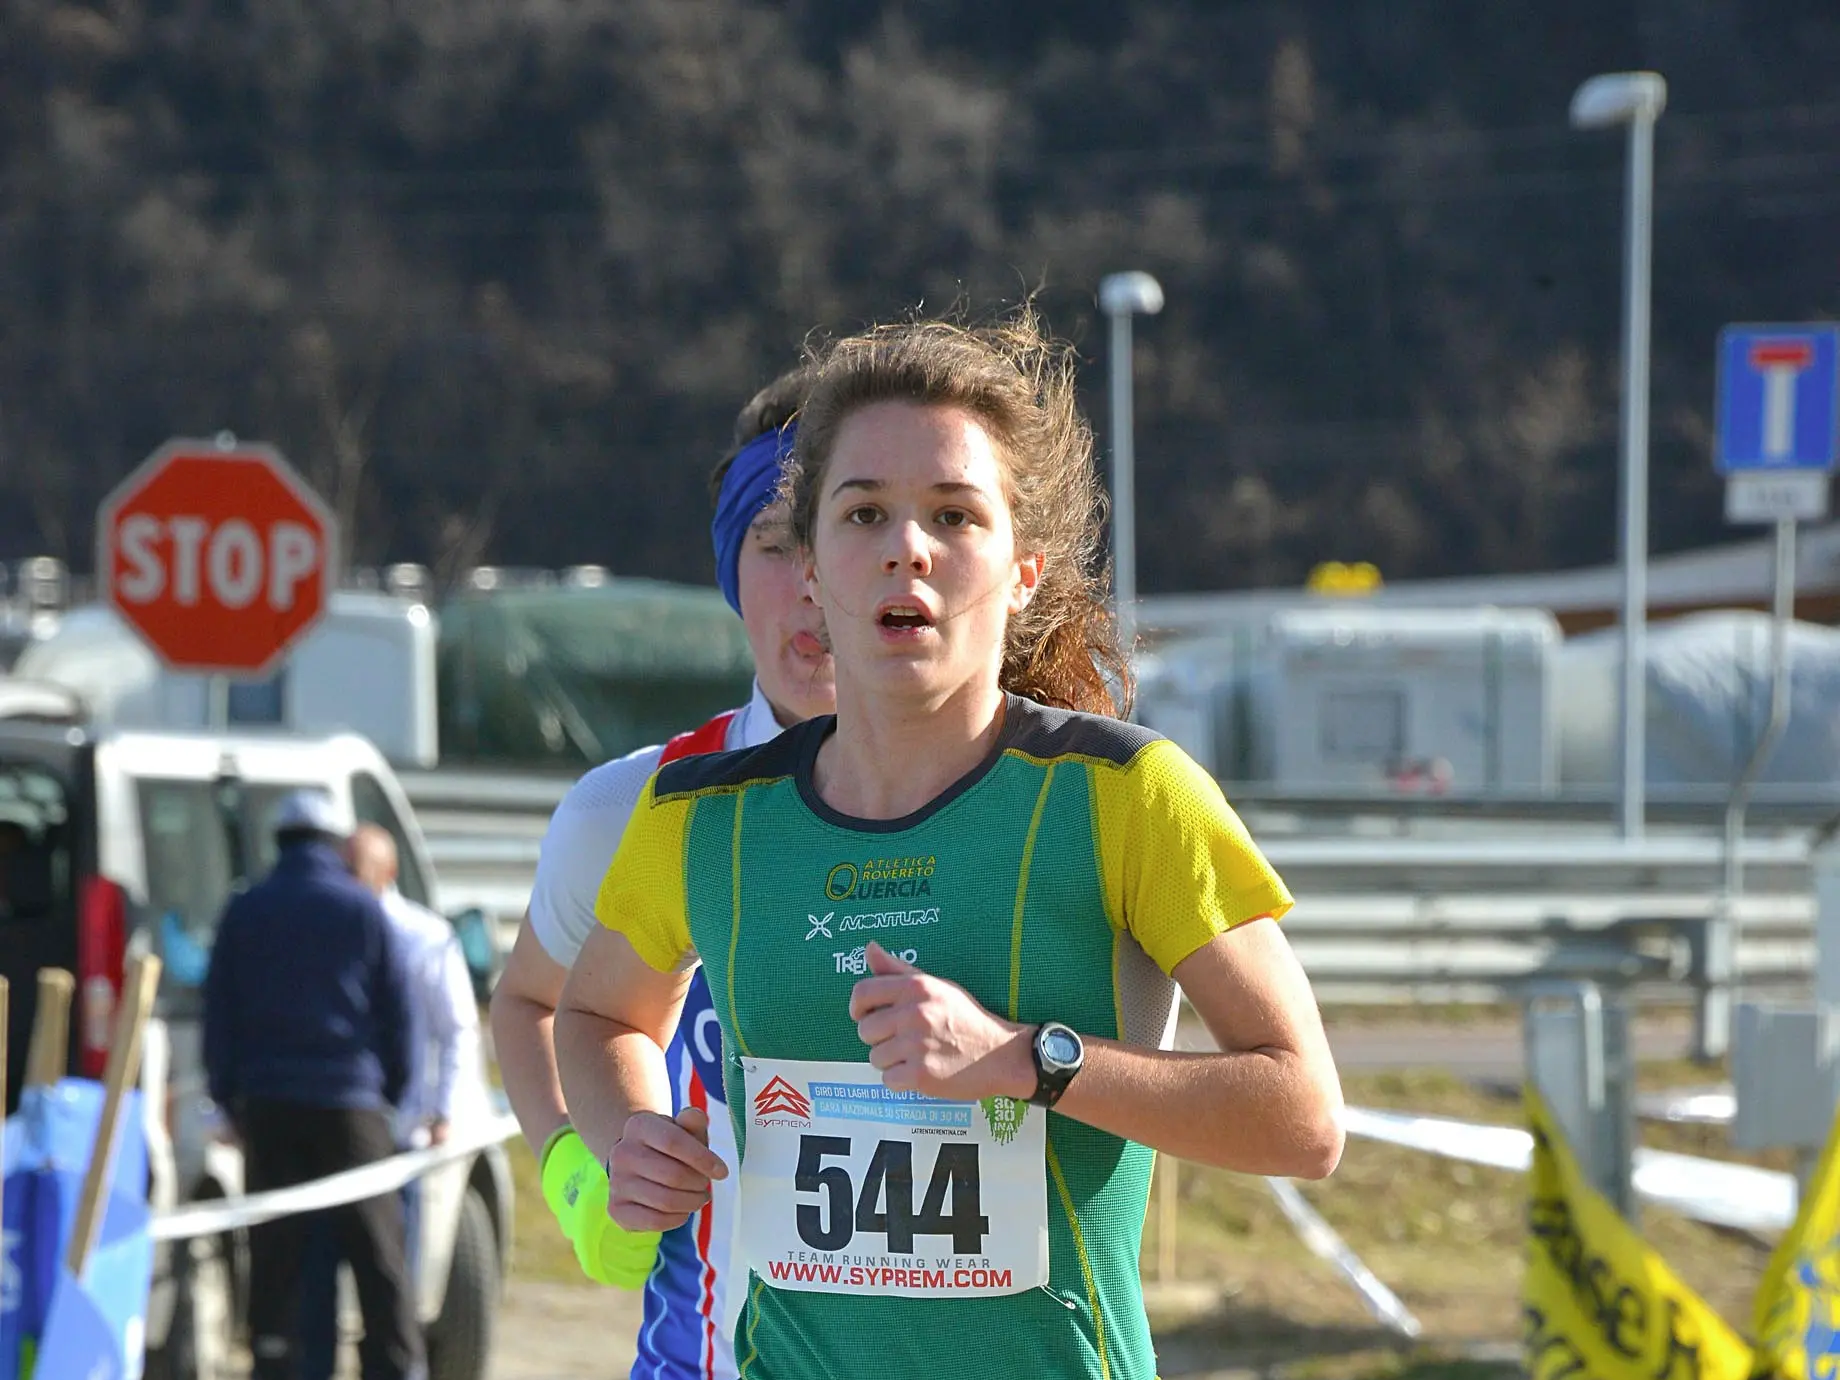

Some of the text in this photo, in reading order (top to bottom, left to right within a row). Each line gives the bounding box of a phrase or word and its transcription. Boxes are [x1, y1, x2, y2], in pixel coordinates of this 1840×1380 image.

[118, 513, 316, 613] STOP
[863, 856, 937, 870] ATLETICA
[862, 866, 935, 881] ROVERETO
[839, 909, 939, 931] MONTURA
[814, 1086, 833, 1097] GIRO
[834, 1087, 847, 1098] DEI
[847, 1088, 870, 1099] LAGHI
[871, 1089, 880, 1099] DI
[895, 1108, 927, 1121] STRADA
[929, 1110, 938, 1121] DI
[940, 1111, 952, 1122] 30
[954, 1111, 968, 1123] KM
[911, 1127, 968, 1137] LATRENTATRENTINA.COM
[795, 1134, 990, 1255] 544
[787, 1250, 991, 1269] TEAM RUNNING WEAR
[768, 1260, 1013, 1288] WWW.SYPREM.COM
